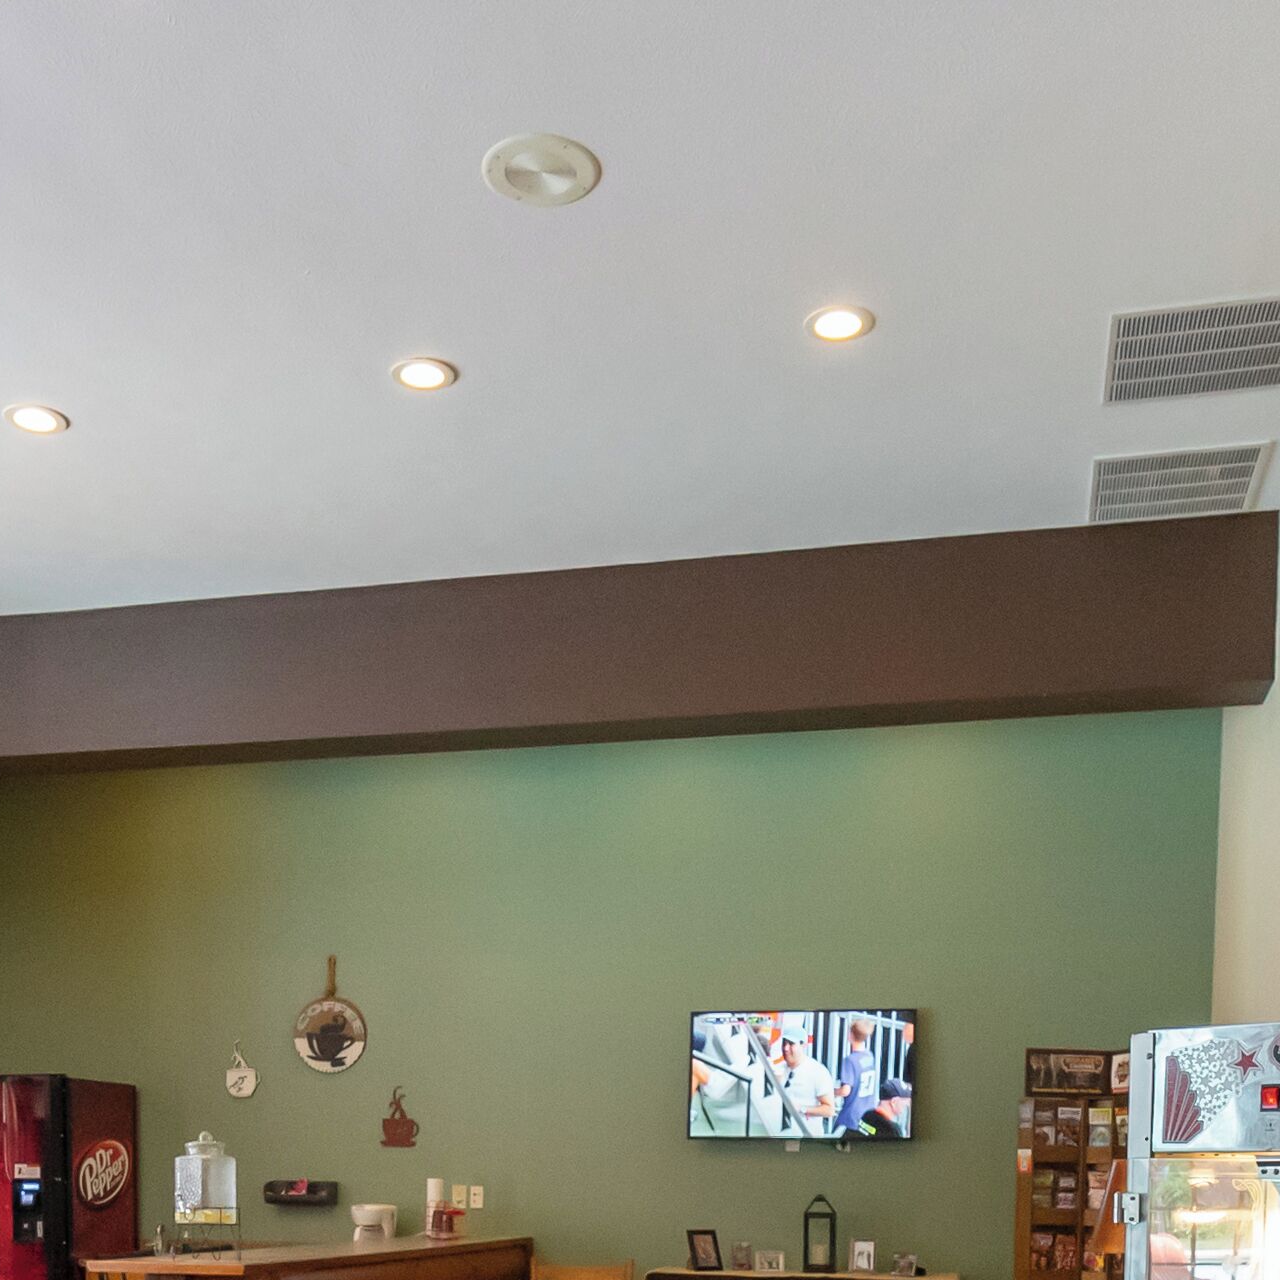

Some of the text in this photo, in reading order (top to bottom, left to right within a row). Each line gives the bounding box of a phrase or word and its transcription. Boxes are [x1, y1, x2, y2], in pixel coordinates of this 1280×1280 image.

[297, 1001, 364, 1036] COFFEE
[81, 1154, 125, 1201] Pepper
[96, 1148, 113, 1174] Dr
